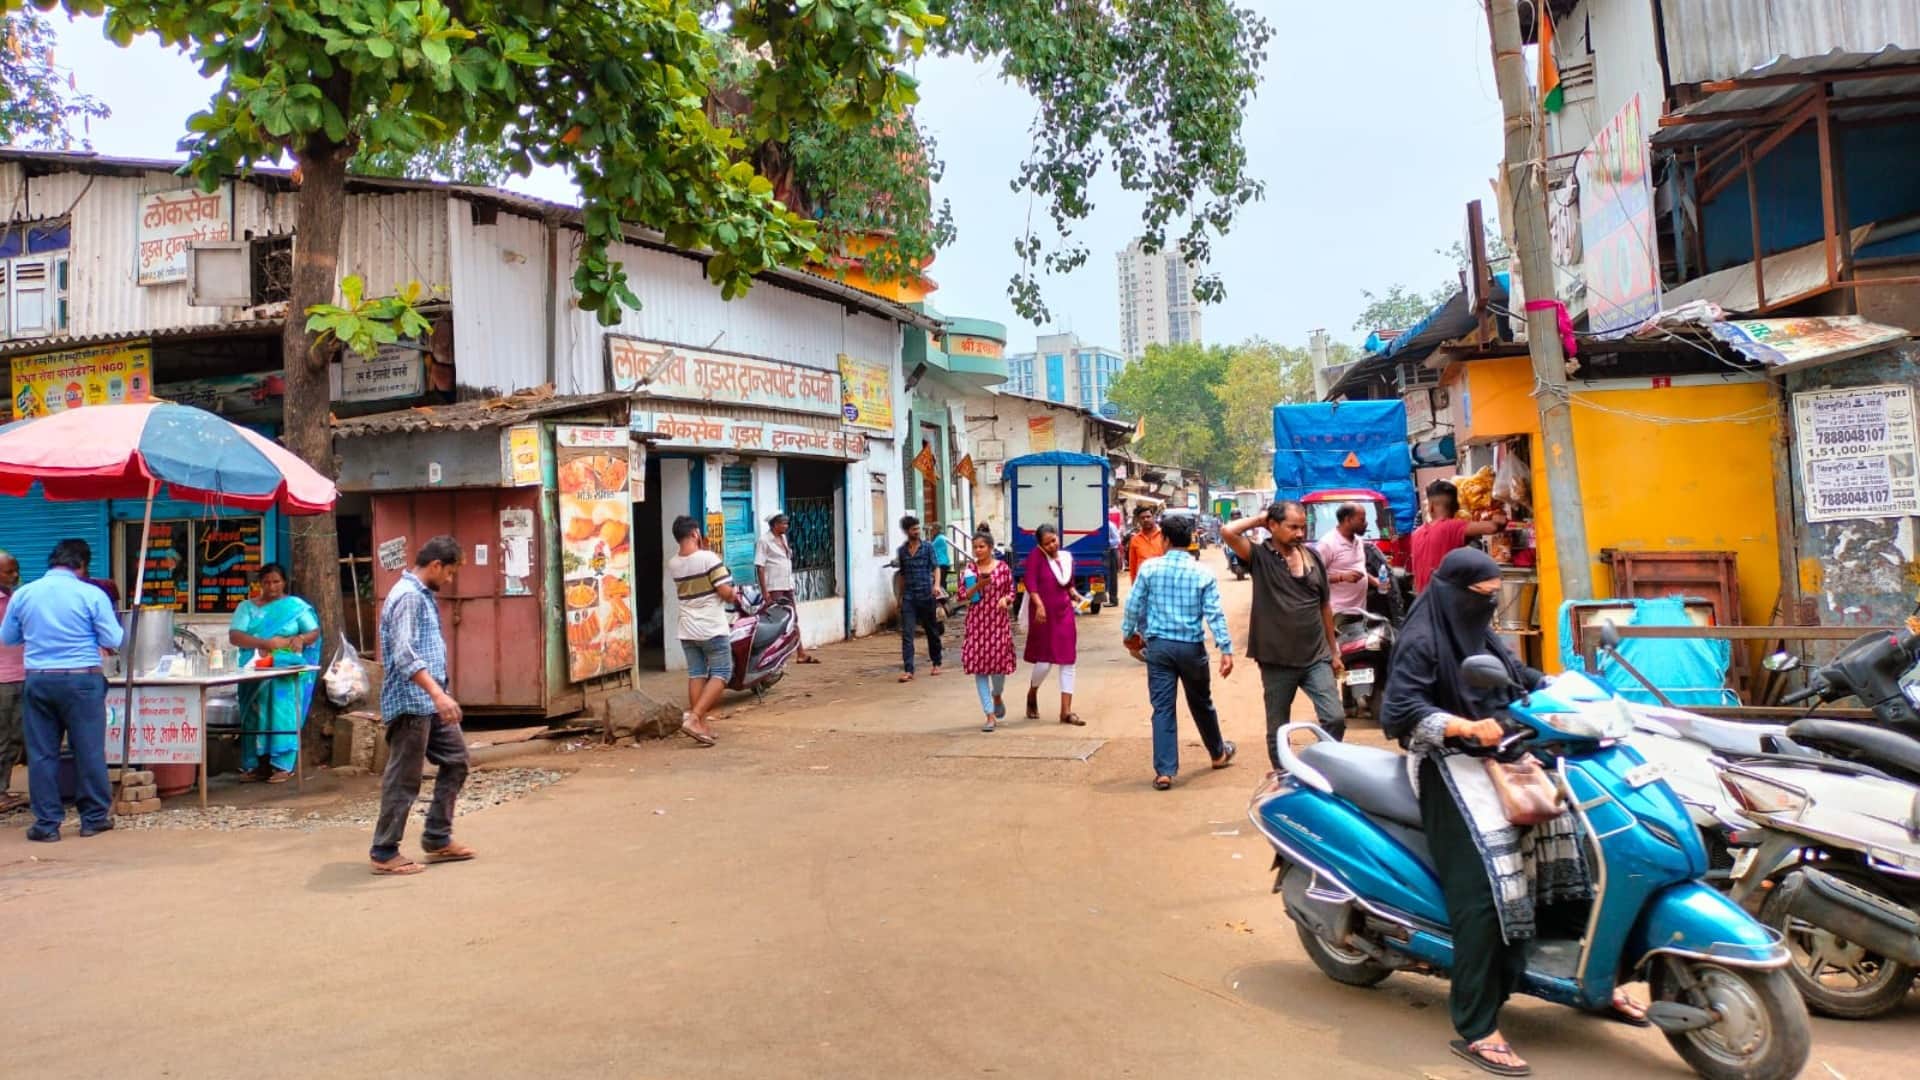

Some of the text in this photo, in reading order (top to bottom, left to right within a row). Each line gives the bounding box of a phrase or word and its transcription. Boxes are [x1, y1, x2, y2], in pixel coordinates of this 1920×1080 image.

[143, 189, 221, 228] लोकसेवा
[99, 361, 128, 374] (NGO)
[738, 362, 796, 399] ट्रान्सपोर्ट
[656, 413, 723, 443] लोकसेवा
[1817, 428, 1885, 445] 7888048107
[1821, 489, 1889, 507] 7888048107
